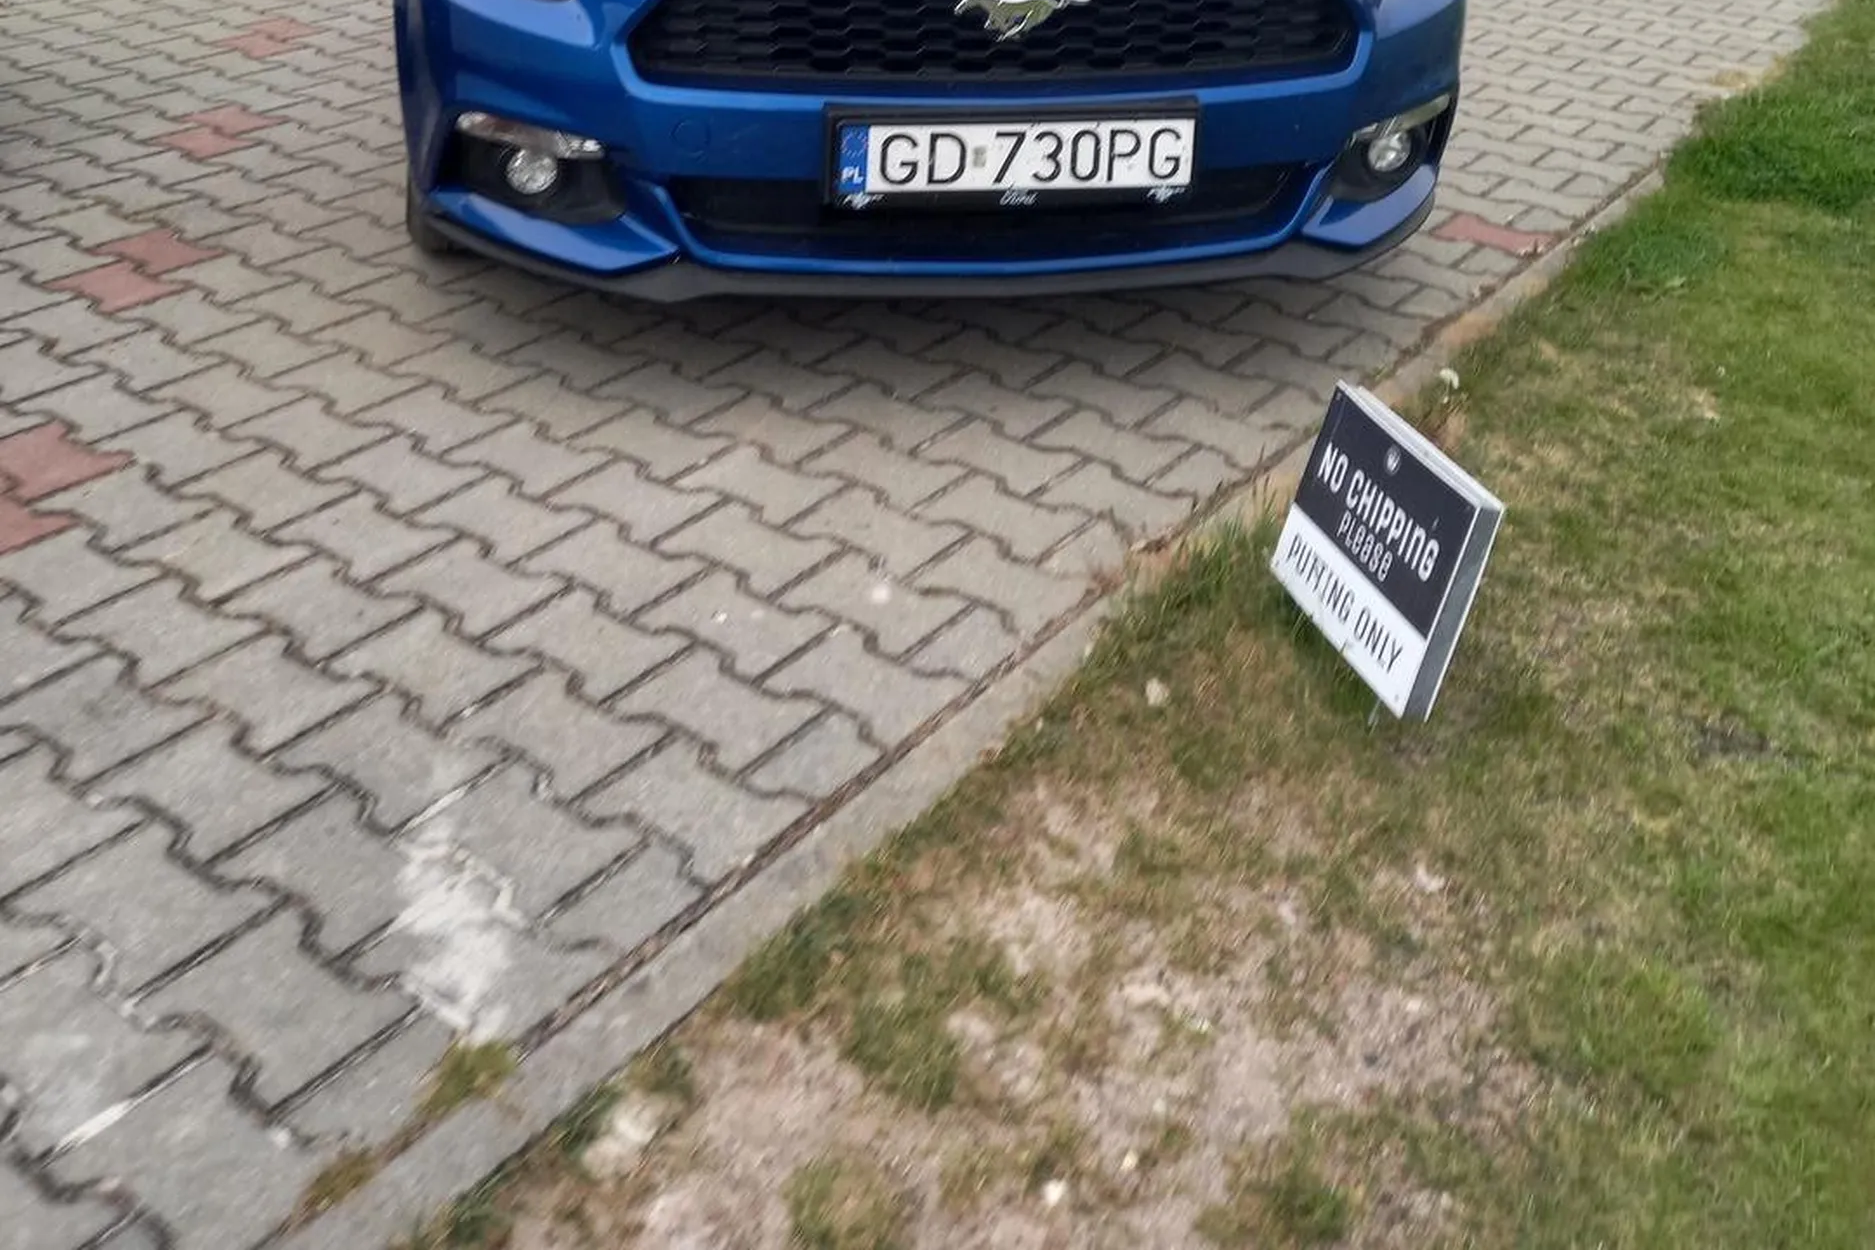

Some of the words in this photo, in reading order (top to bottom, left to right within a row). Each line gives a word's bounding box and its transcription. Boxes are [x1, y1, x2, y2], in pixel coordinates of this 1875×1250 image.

[841, 166, 864, 185] PL
[879, 132, 967, 185] GD
[991, 128, 1183, 184] 730PG
[1317, 441, 1349, 494] NO
[1354, 606, 1403, 674] ONLY
